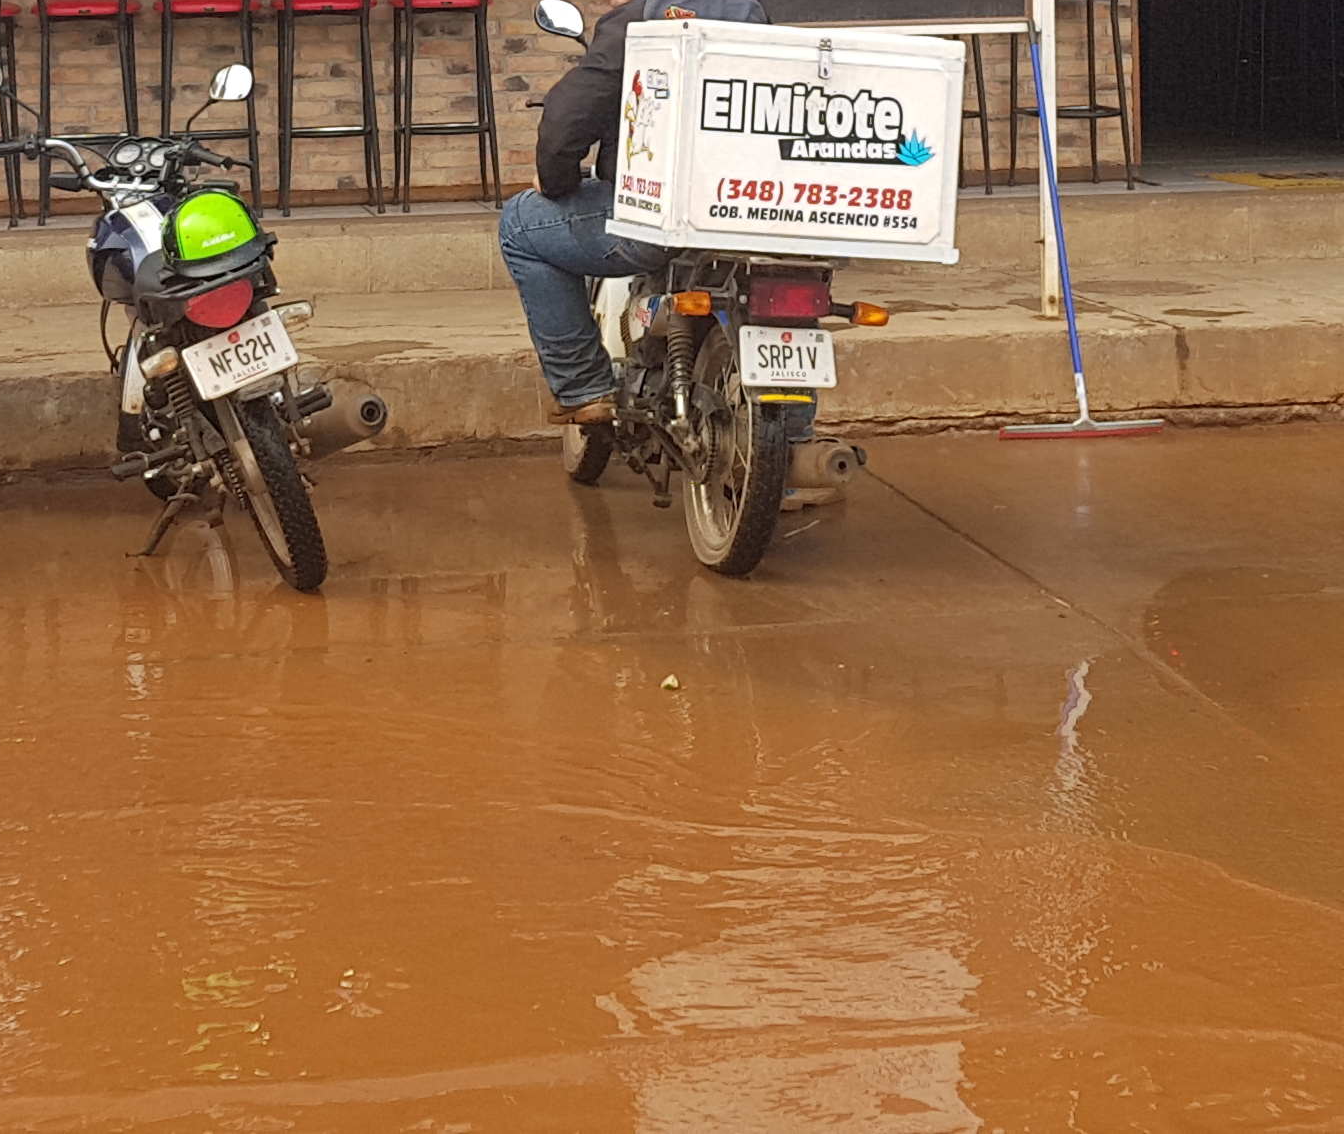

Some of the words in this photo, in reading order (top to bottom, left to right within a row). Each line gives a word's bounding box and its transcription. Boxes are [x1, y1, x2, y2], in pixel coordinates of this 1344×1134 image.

[701, 78, 747, 133] El
[751, 81, 904, 142] Mitote
[790, 140, 897, 160] Arandas
[716, 177, 784, 205] (348)
[793, 183, 913, 210] 783-2388
[709, 204, 743, 219] GOB.
[747, 208, 804, 223] MEDINA
[808, 211, 878, 227] ASCENCIO
[883, 216, 918, 229] #554
[208, 331, 276, 377] NFG2H
[757, 344, 817, 370] SRP1V
[232, 361, 268, 381] JALISCO
[770, 370, 807, 378] JALISCO
